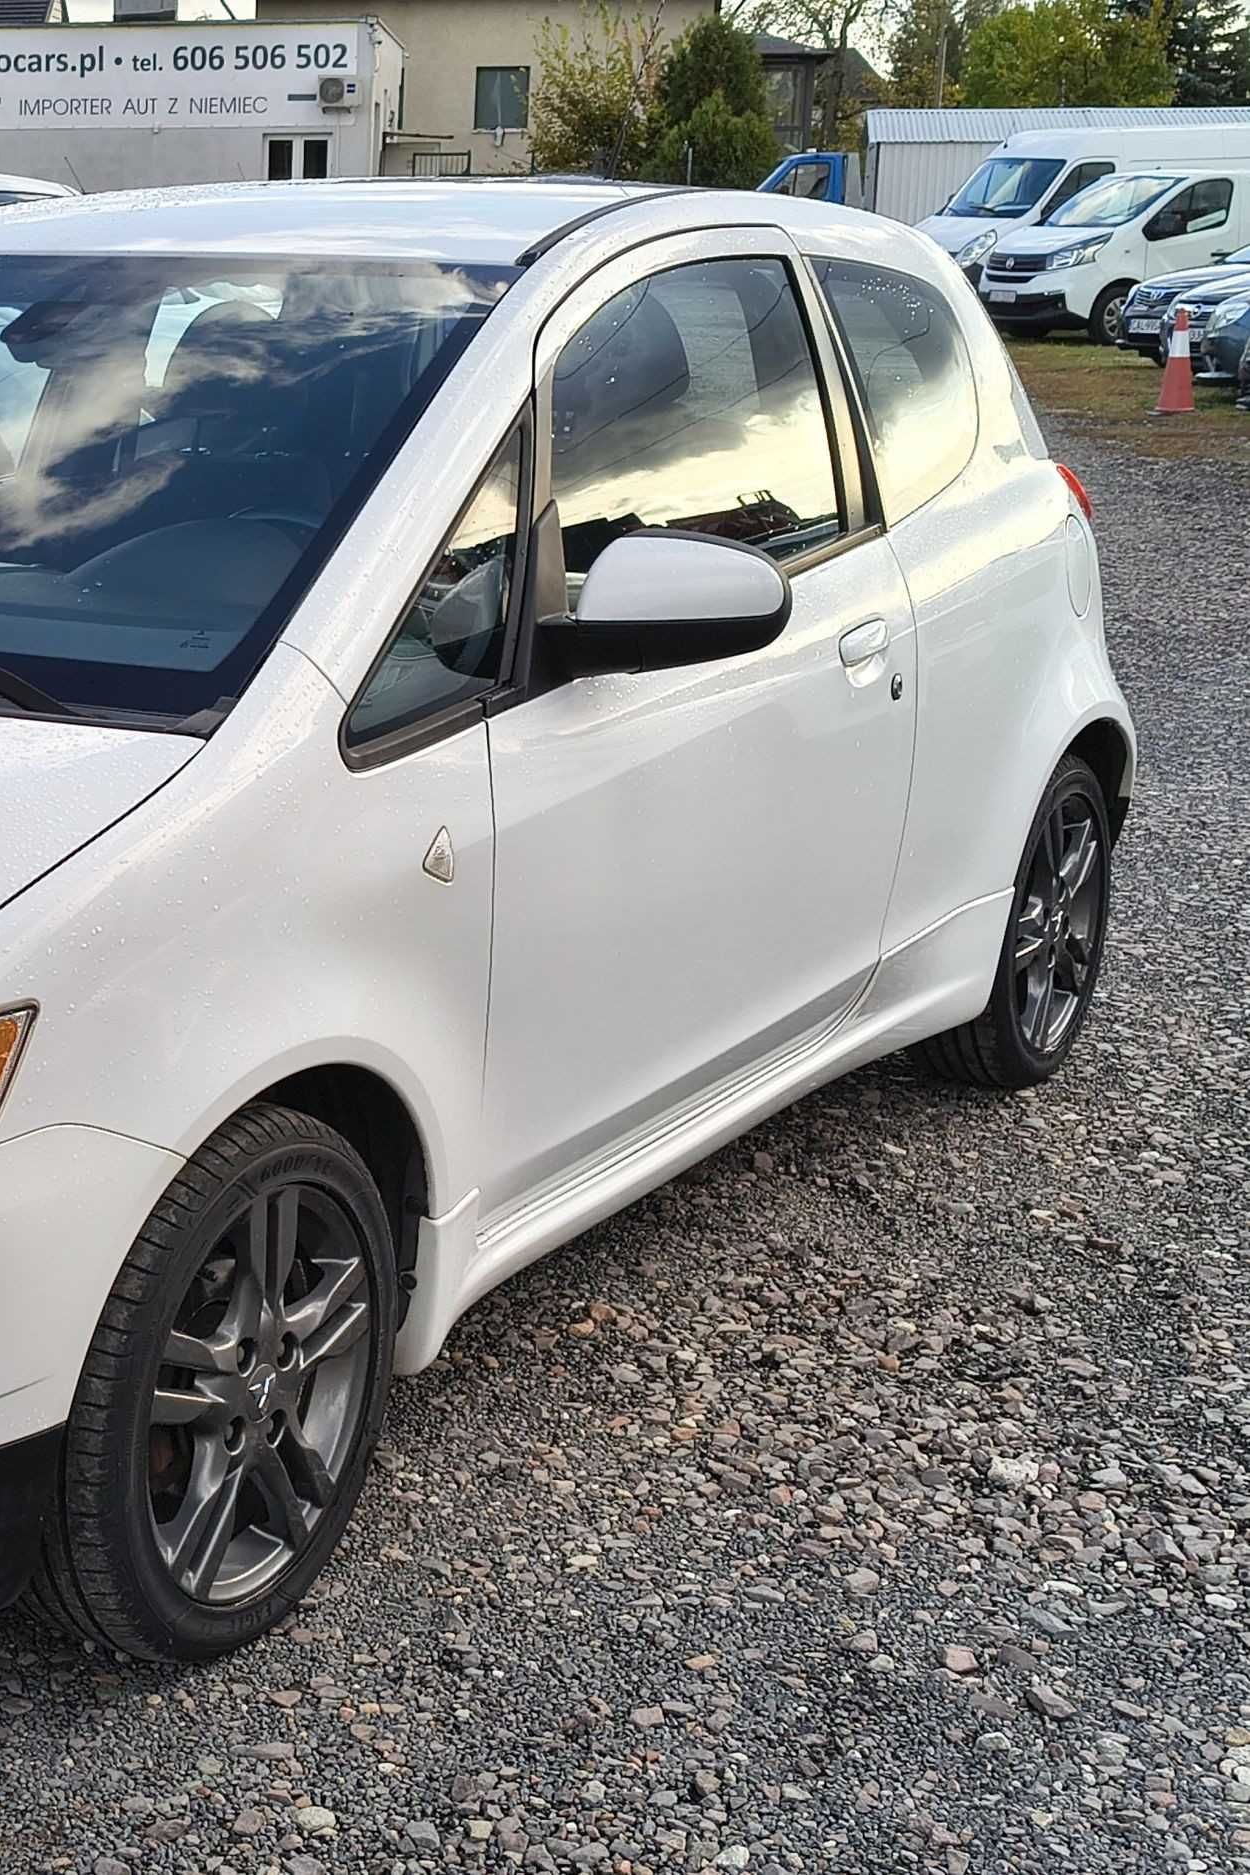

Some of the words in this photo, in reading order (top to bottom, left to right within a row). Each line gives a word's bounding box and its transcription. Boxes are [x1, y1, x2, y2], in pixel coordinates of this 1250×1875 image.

[132, 53, 163, 71] tel.
[173, 45, 225, 71] 606
[234, 44, 286, 70] 506
[296, 43, 348, 69] 502
[19, 98, 111, 116] IMPORTER
[122, 97, 158, 115] AUT
[168, 98, 179, 115] Z
[190, 96, 268, 115] NIEMIEC
